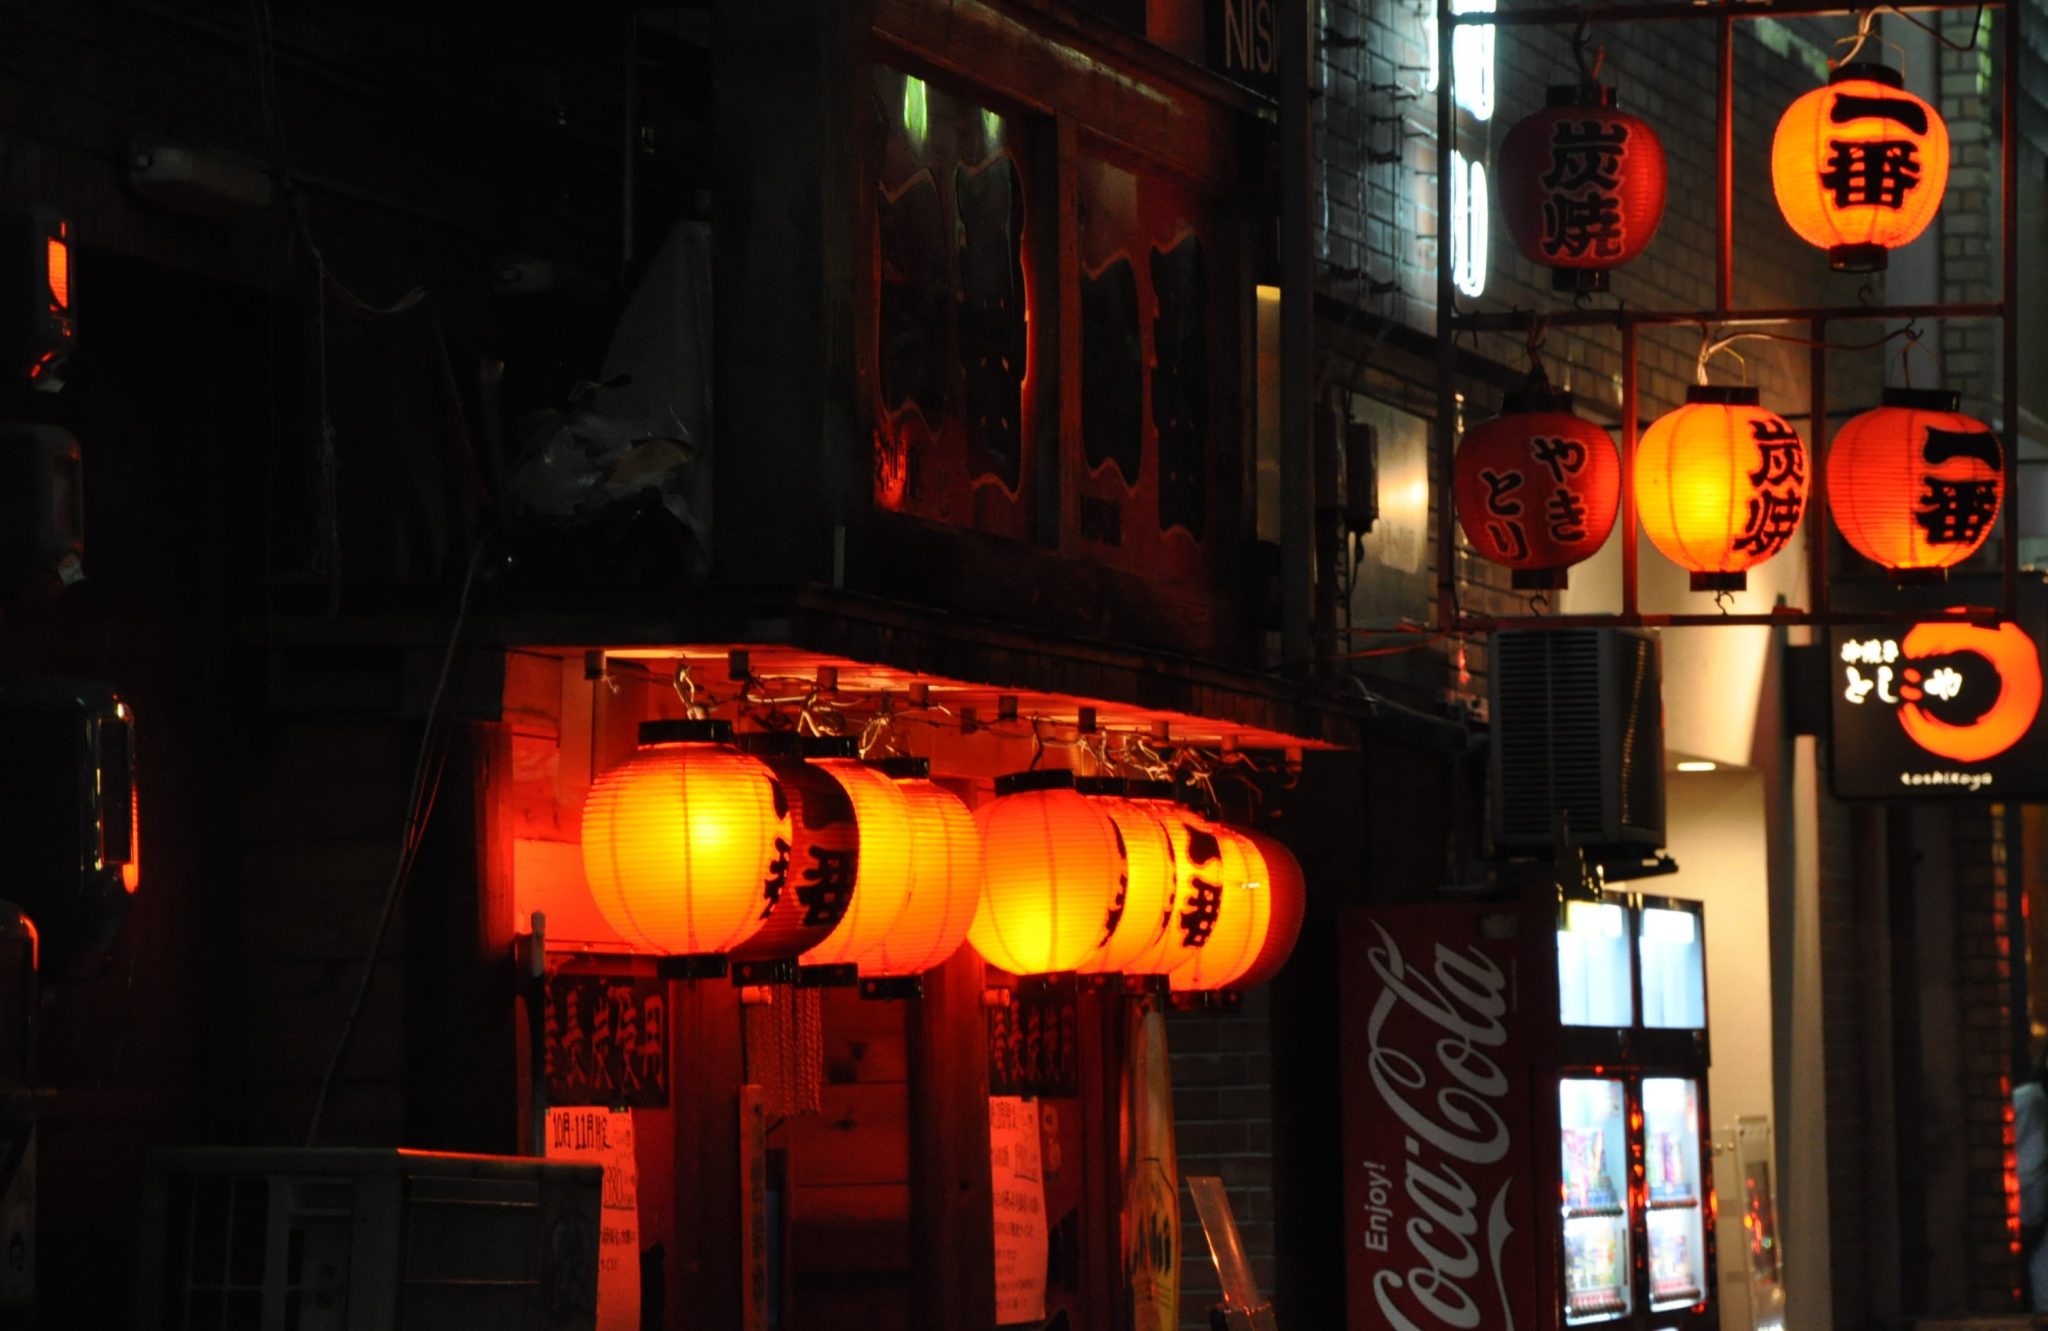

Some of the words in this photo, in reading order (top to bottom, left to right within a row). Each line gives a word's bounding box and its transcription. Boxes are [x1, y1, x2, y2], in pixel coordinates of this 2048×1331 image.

[1543, 120, 1628, 258] 炭焼
[1820, 95, 1928, 208] 一番
[1481, 469, 1526, 560] とり
[1533, 437, 1588, 542] やき
[1734, 419, 1805, 556] 炭焼
[1913, 425, 2000, 544] 一番
[1364, 1160, 1394, 1253] Enjoy!
